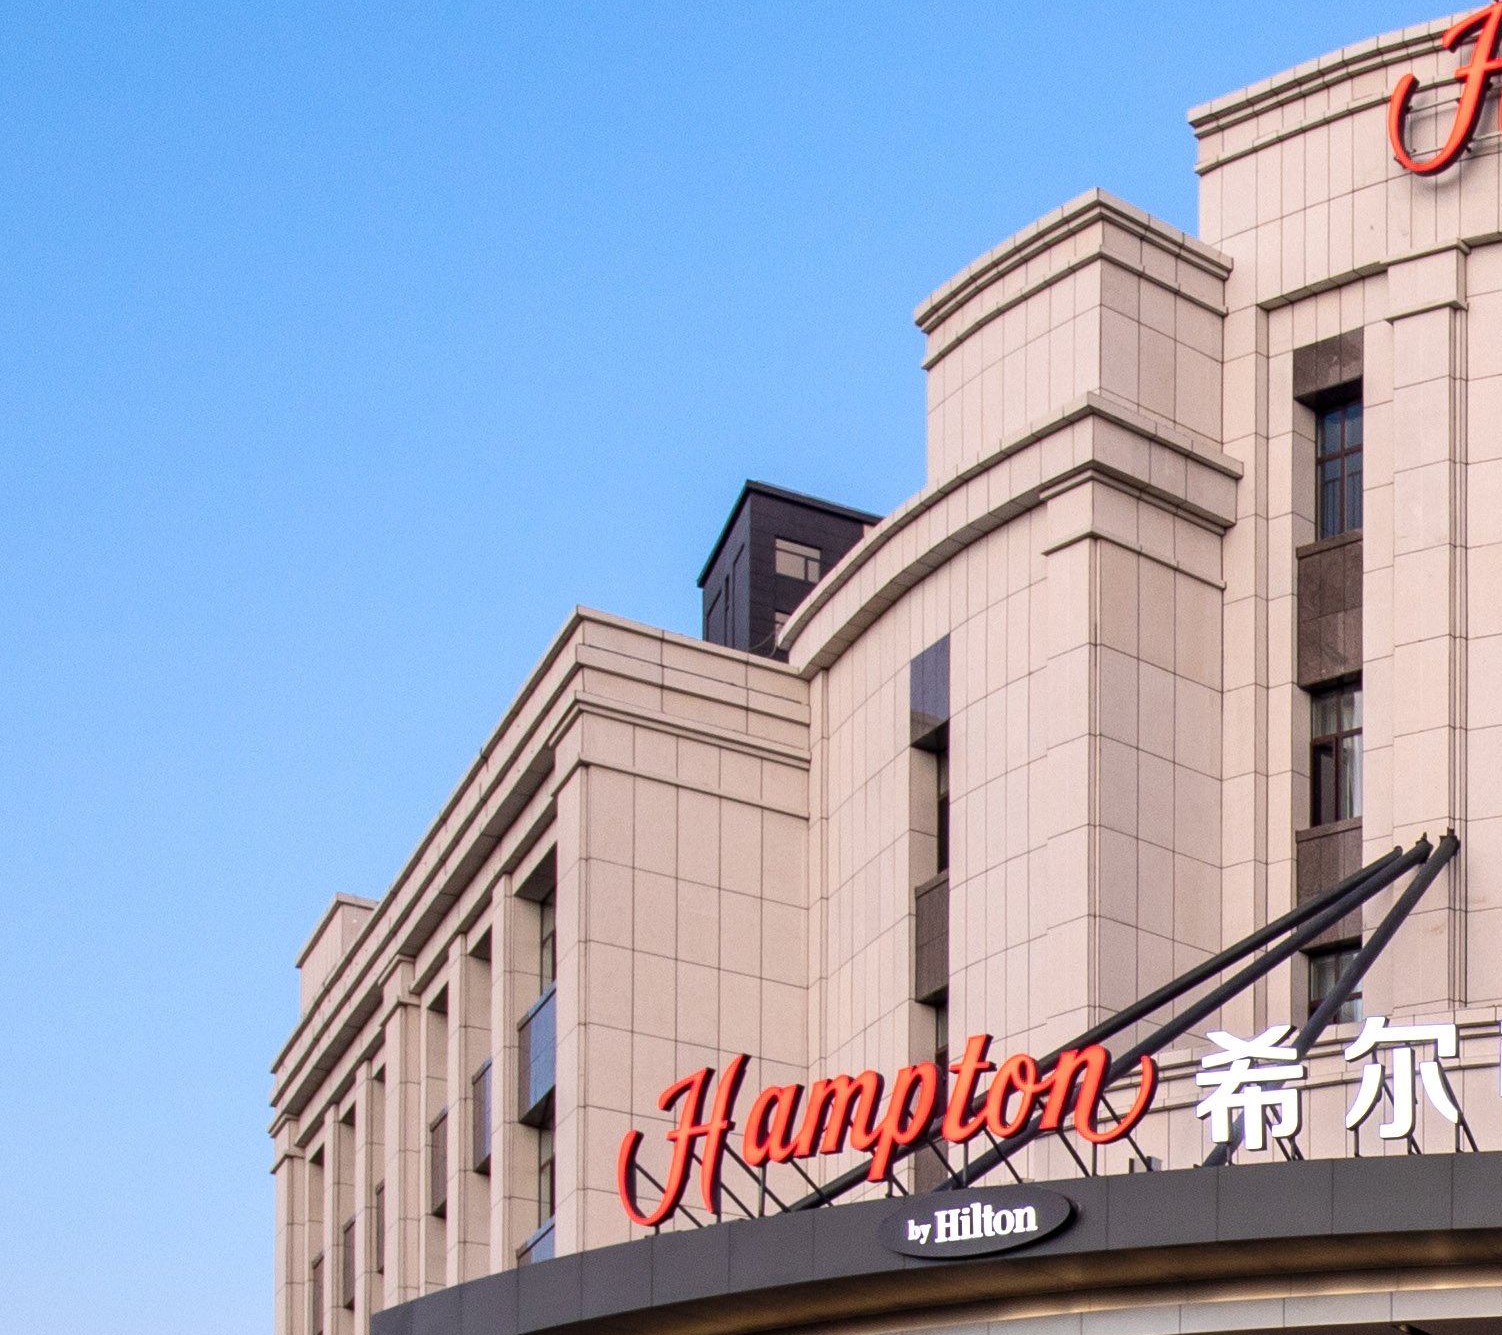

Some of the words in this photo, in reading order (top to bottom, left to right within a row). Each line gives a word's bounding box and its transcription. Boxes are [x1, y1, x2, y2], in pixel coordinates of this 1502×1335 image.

[618, 1033, 1158, 1227] Hampton
[907, 1219, 931, 1244] by
[934, 1202, 1038, 1244] Hilton
